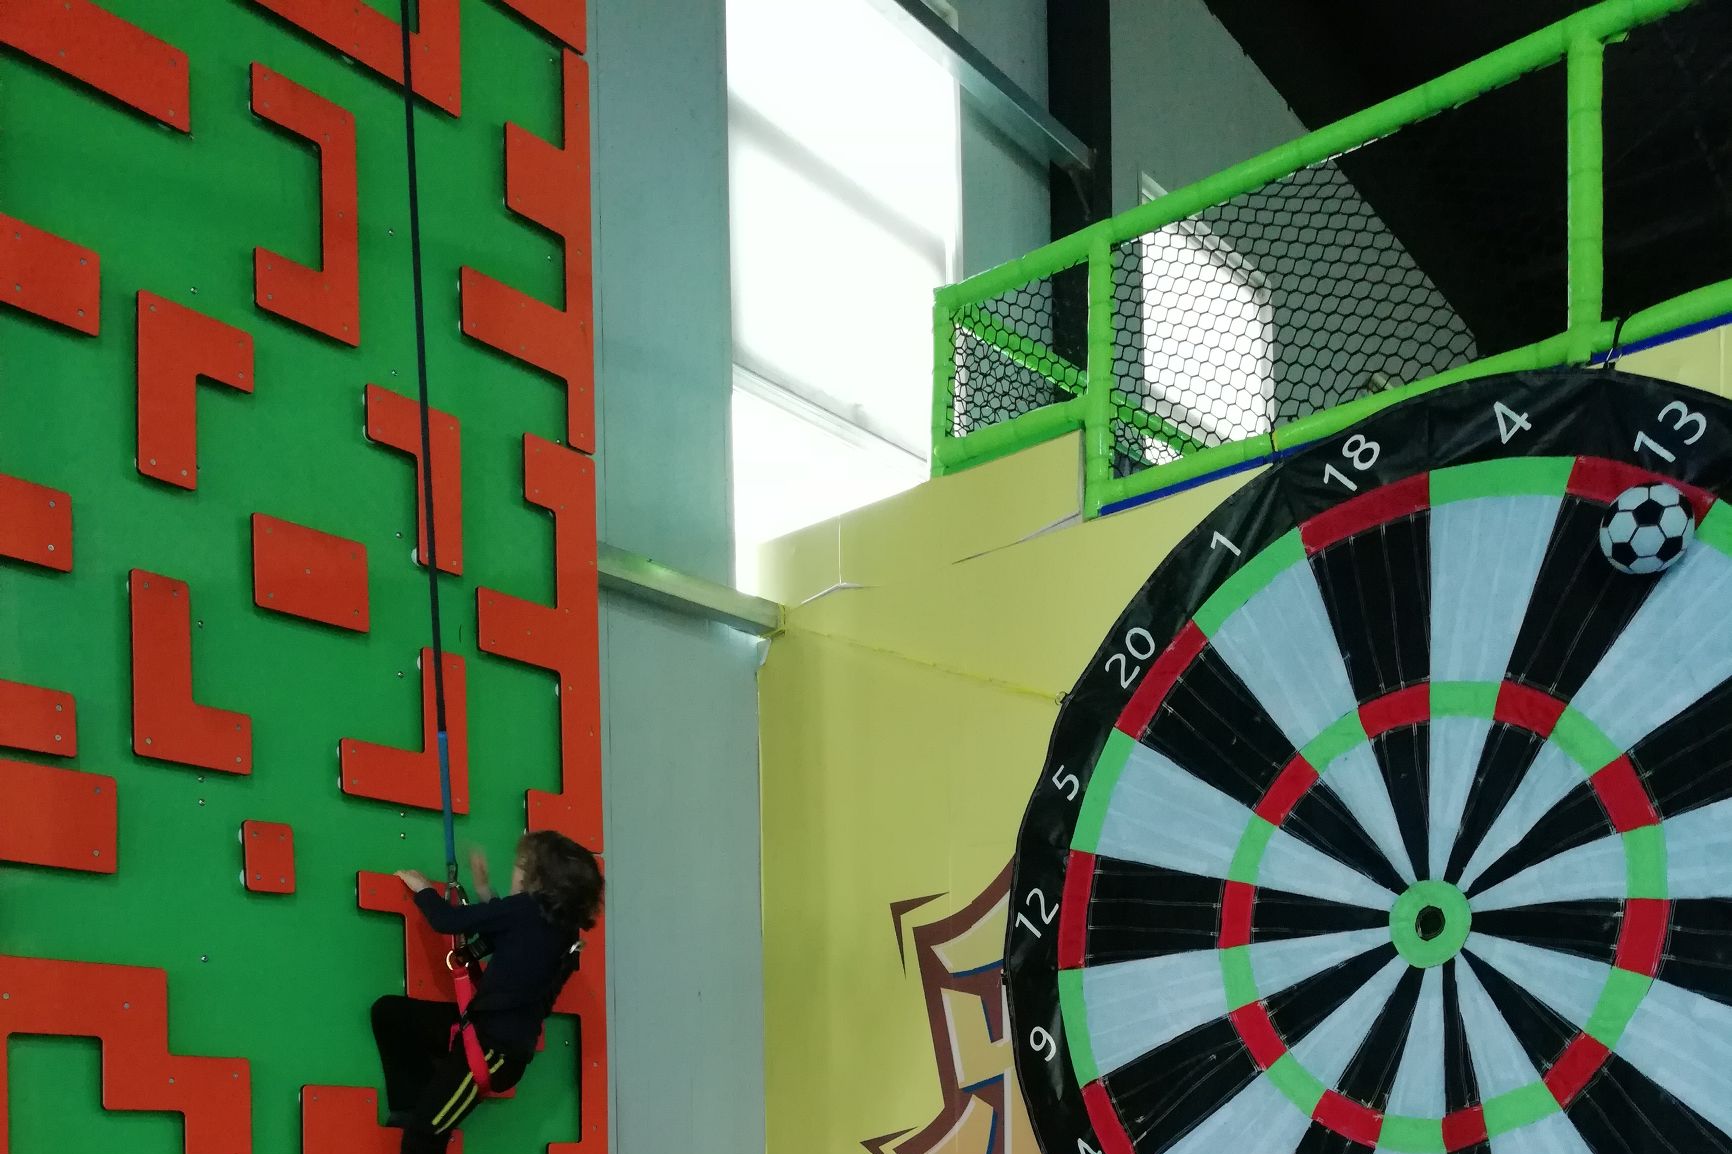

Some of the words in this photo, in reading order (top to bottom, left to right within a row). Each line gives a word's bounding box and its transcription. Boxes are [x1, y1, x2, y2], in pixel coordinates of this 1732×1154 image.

[1492, 401, 1532, 445] 4
[1633, 400, 1707, 463] 13
[1323, 433, 1381, 492] 18
[1209, 529, 1242, 557] 1
[1104, 626, 1157, 689] 20
[1052, 764, 1081, 801] 5
[1015, 887, 1060, 939] 12
[1029, 1026, 1057, 1062] 9
